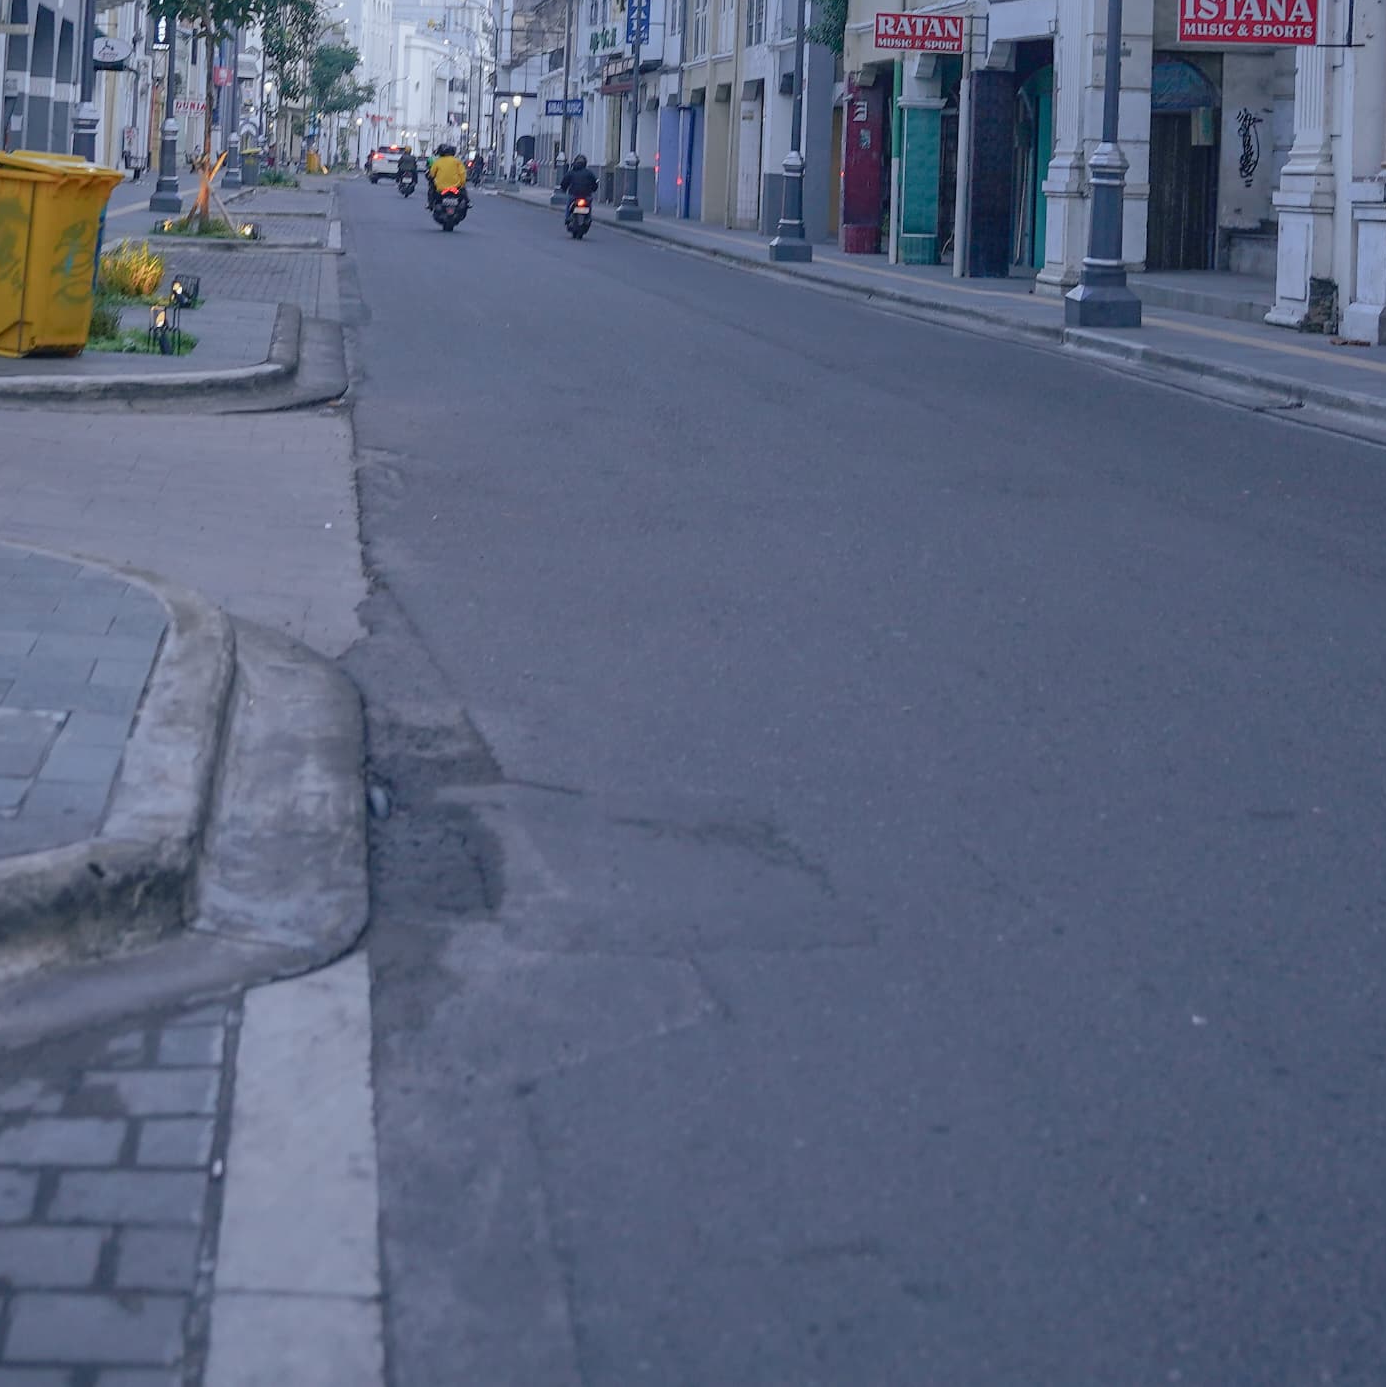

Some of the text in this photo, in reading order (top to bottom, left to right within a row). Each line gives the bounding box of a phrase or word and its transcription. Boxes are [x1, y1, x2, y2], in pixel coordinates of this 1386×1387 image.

[877, 15, 961, 38] RATAN
[1183, 23, 1313, 39] MUSIC & SPORTS
[877, 37, 912, 48] MUSIC
[924, 39, 959, 50] SPORT
[175, 101, 207, 111] DUNIA
